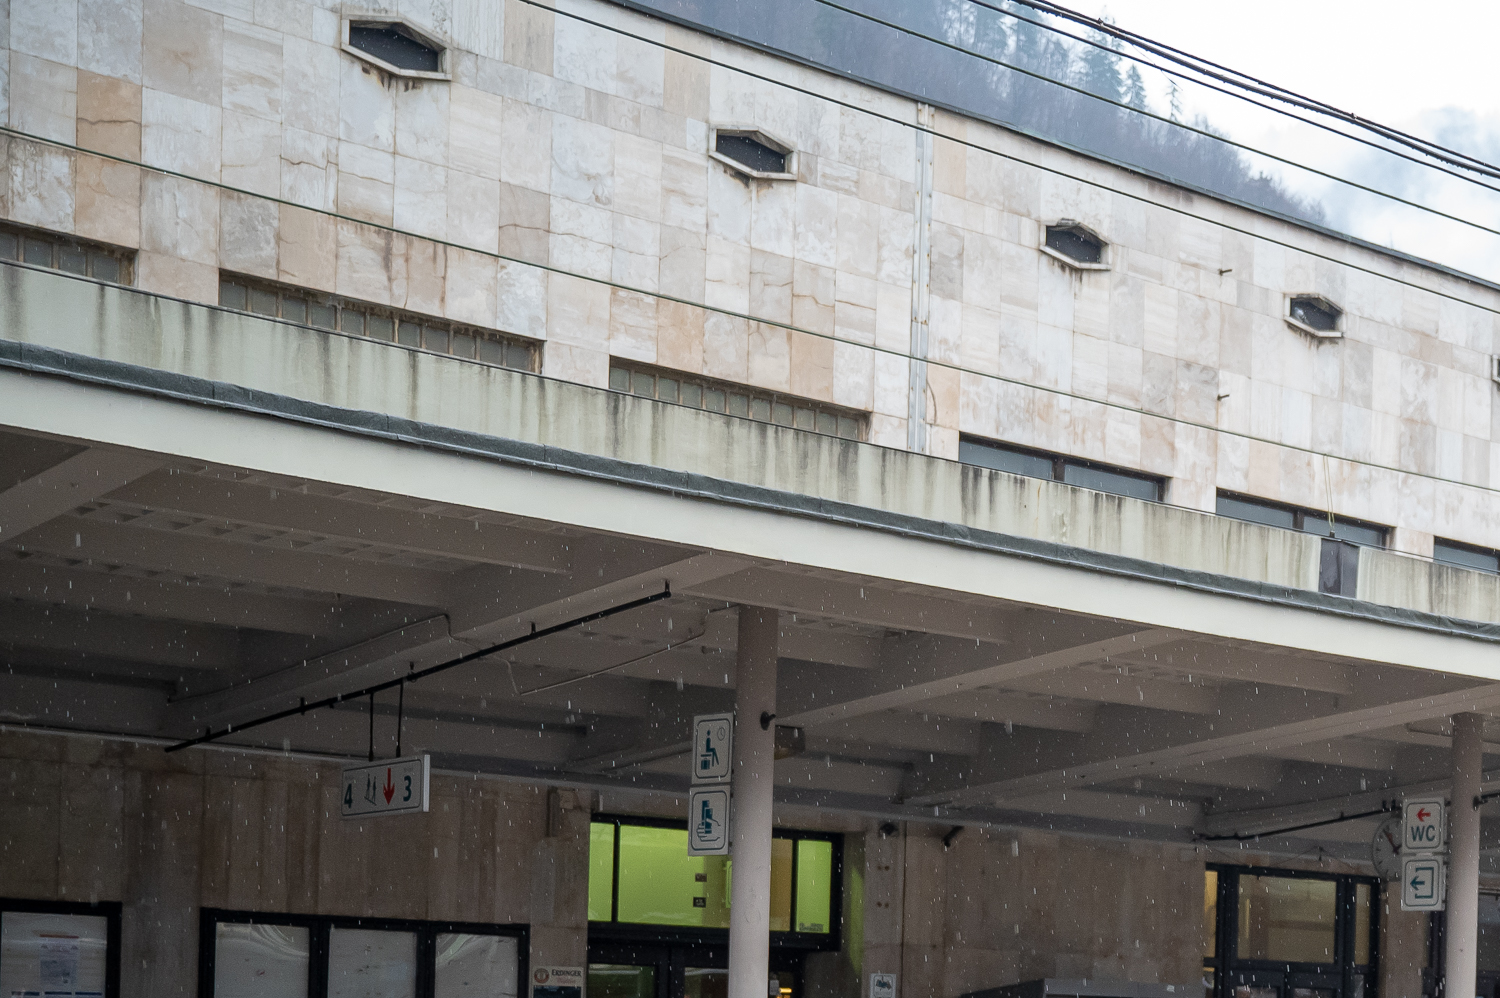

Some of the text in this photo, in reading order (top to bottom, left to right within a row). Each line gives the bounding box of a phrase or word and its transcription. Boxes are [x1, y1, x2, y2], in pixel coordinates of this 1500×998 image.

[344, 783, 353, 809] 4
[403, 775, 412, 802] 3
[1411, 825, 1435, 842] WC
[551, 969, 582, 977] ERDINGER
